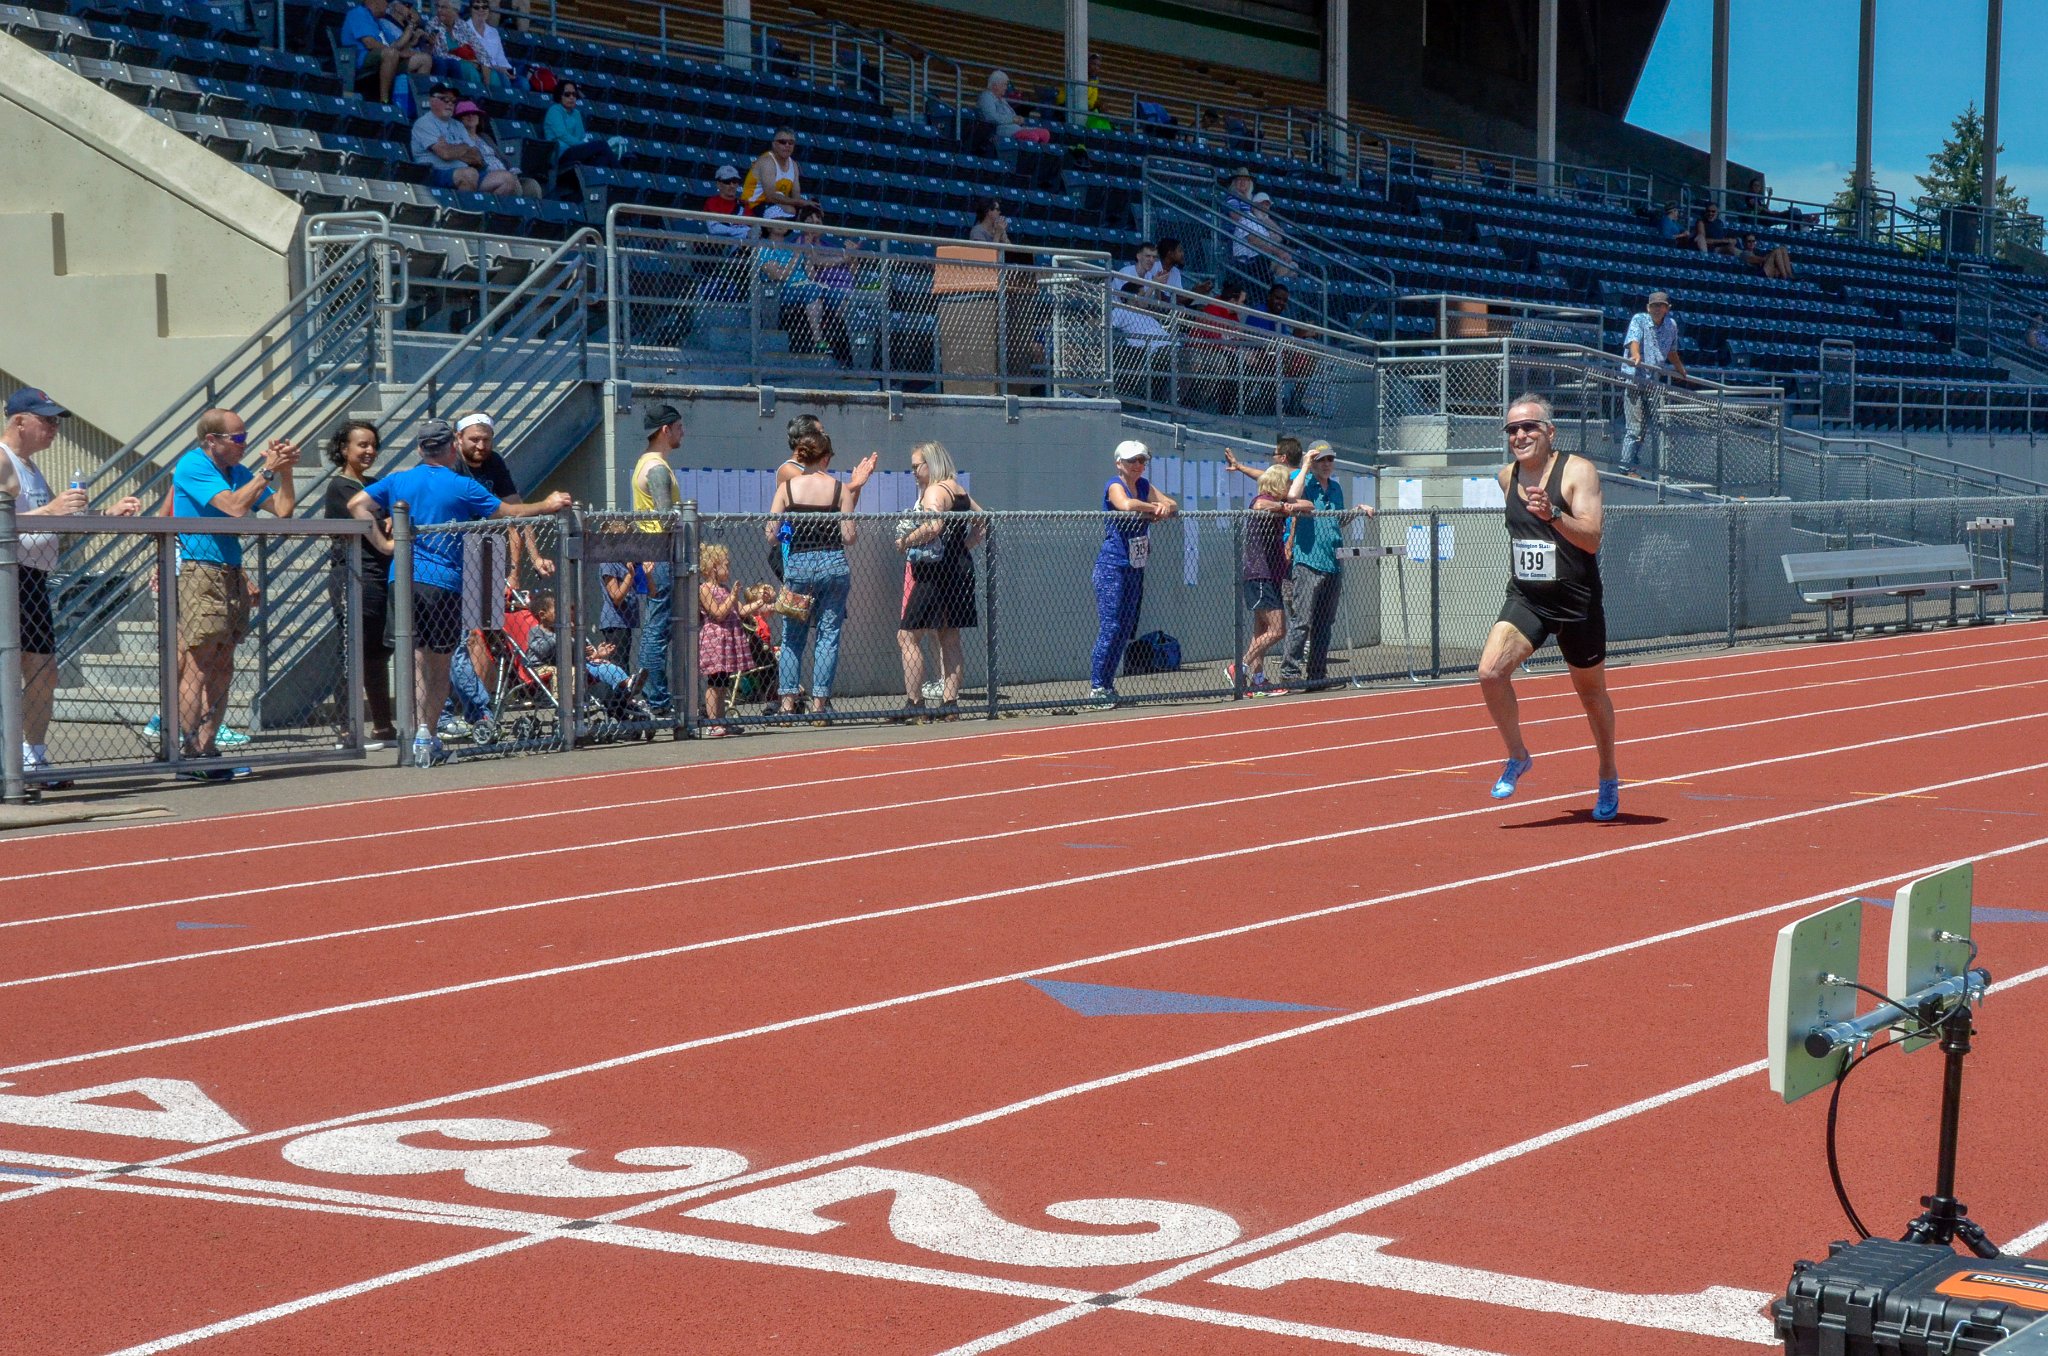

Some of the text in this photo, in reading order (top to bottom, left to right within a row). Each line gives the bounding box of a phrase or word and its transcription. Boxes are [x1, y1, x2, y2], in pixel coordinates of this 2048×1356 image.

[1520, 551, 1544, 571] 439
[281, 1117, 750, 1197] 3
[681, 1165, 1242, 1268] 2
[1204, 1232, 1784, 1346] 1
